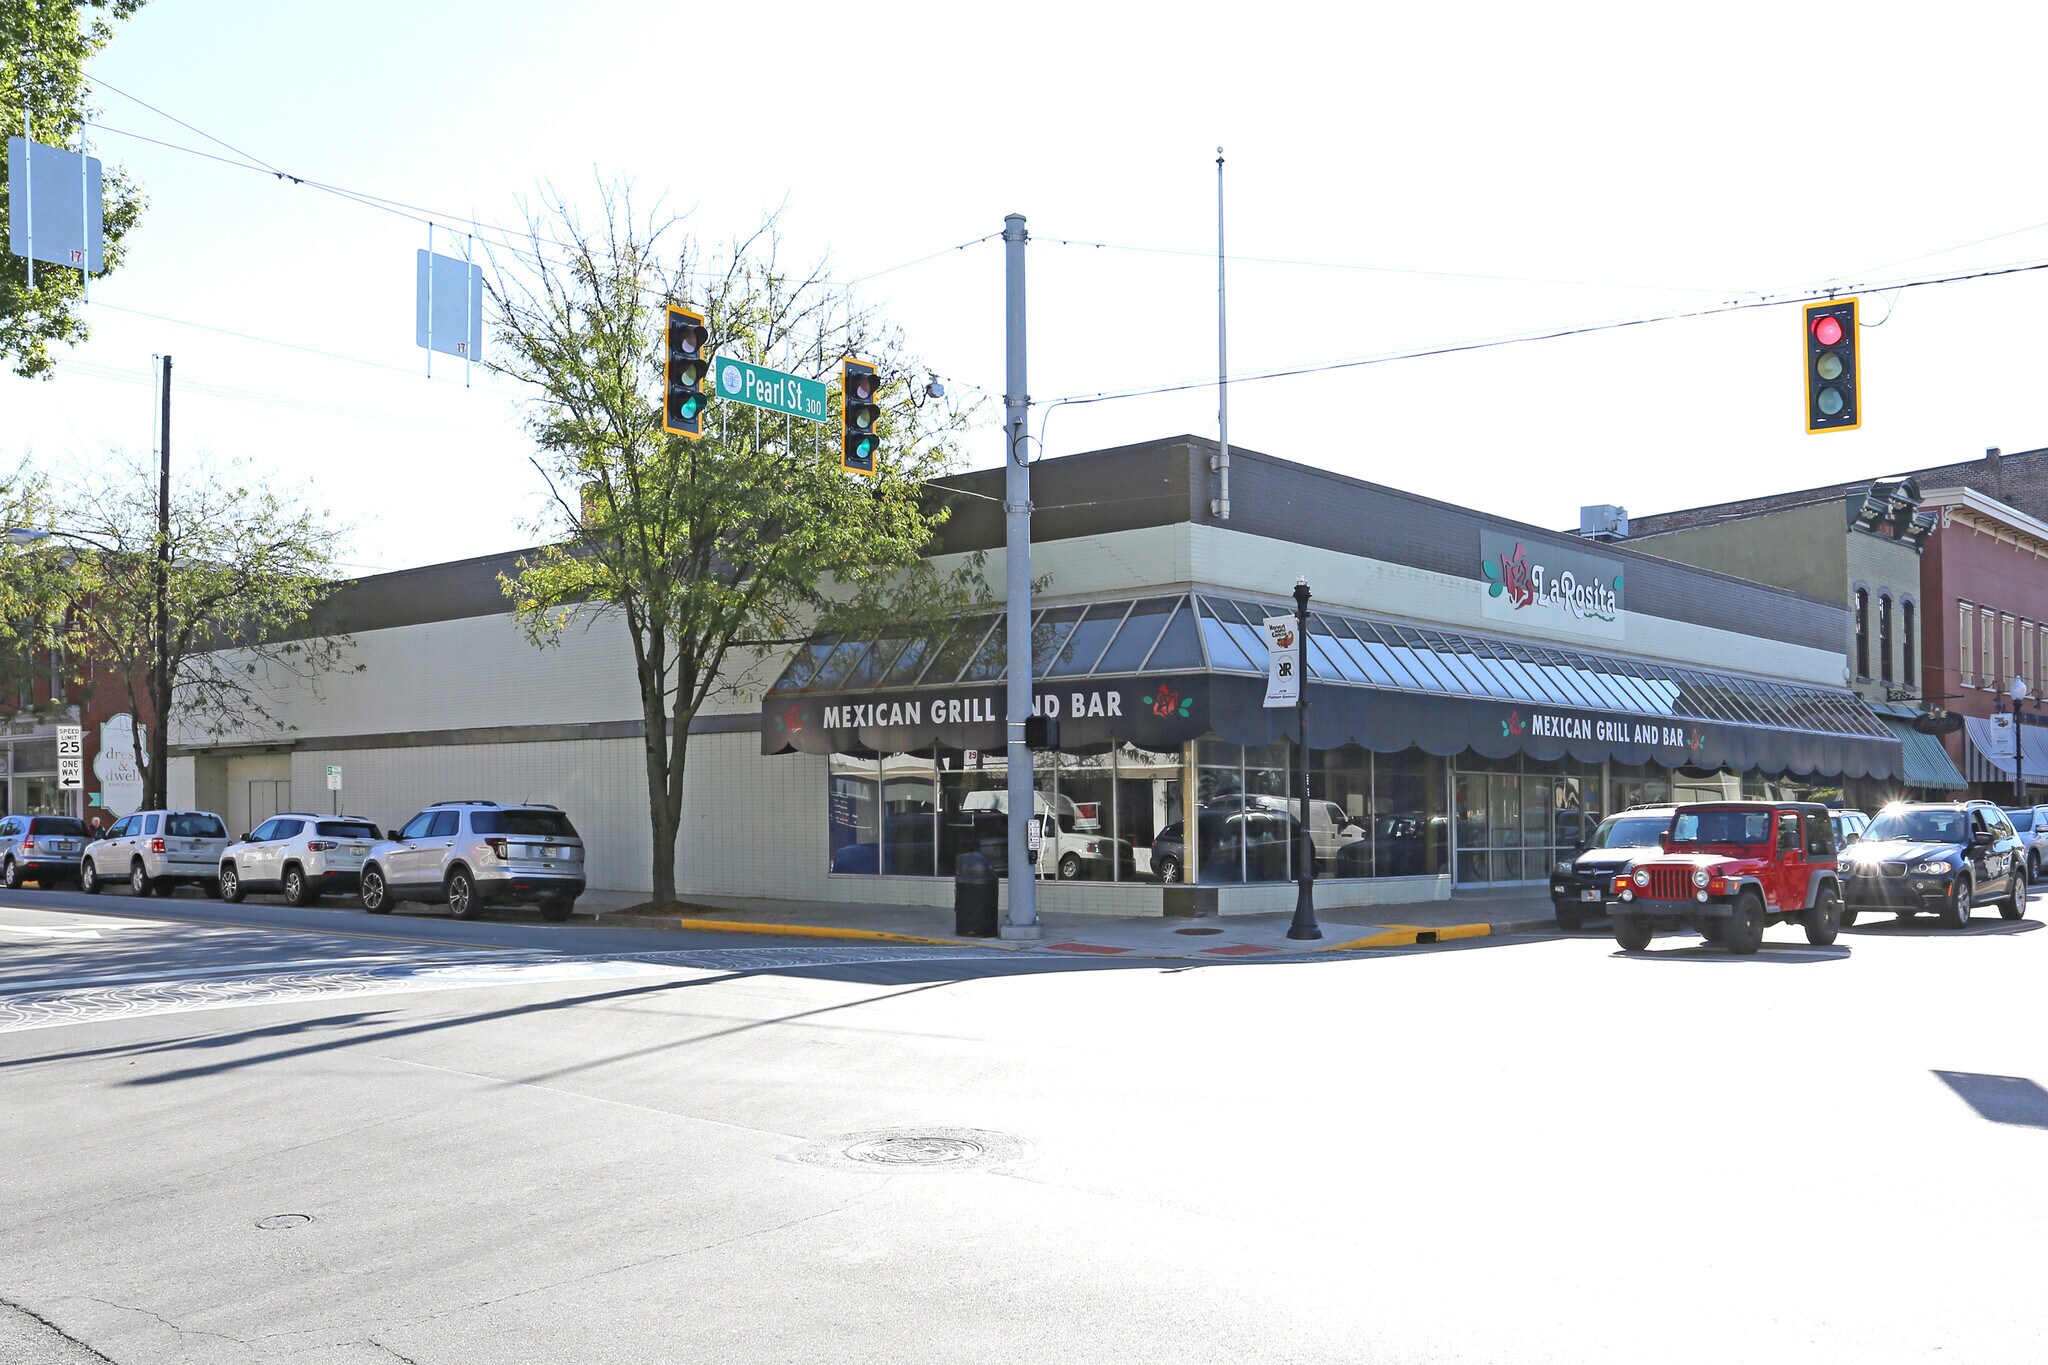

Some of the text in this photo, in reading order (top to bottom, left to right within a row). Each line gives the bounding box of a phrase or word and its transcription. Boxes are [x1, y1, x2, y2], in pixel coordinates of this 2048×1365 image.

[71, 250, 82, 263] 17
[457, 342, 466, 354] 17
[746, 368, 822, 416] Pearl St 300
[823, 691, 1122, 729] MEXICAN GRILL ND BAR
[1532, 714, 1684, 747] MEXICAN GRILL AND BAR
[60, 741, 80, 753] 25
[106, 747, 134, 760] dres
[62, 760, 79, 768] ONE
[118, 761, 128, 772] &
[62, 768, 79, 776] WAY
[106, 769, 140, 781] dwell
